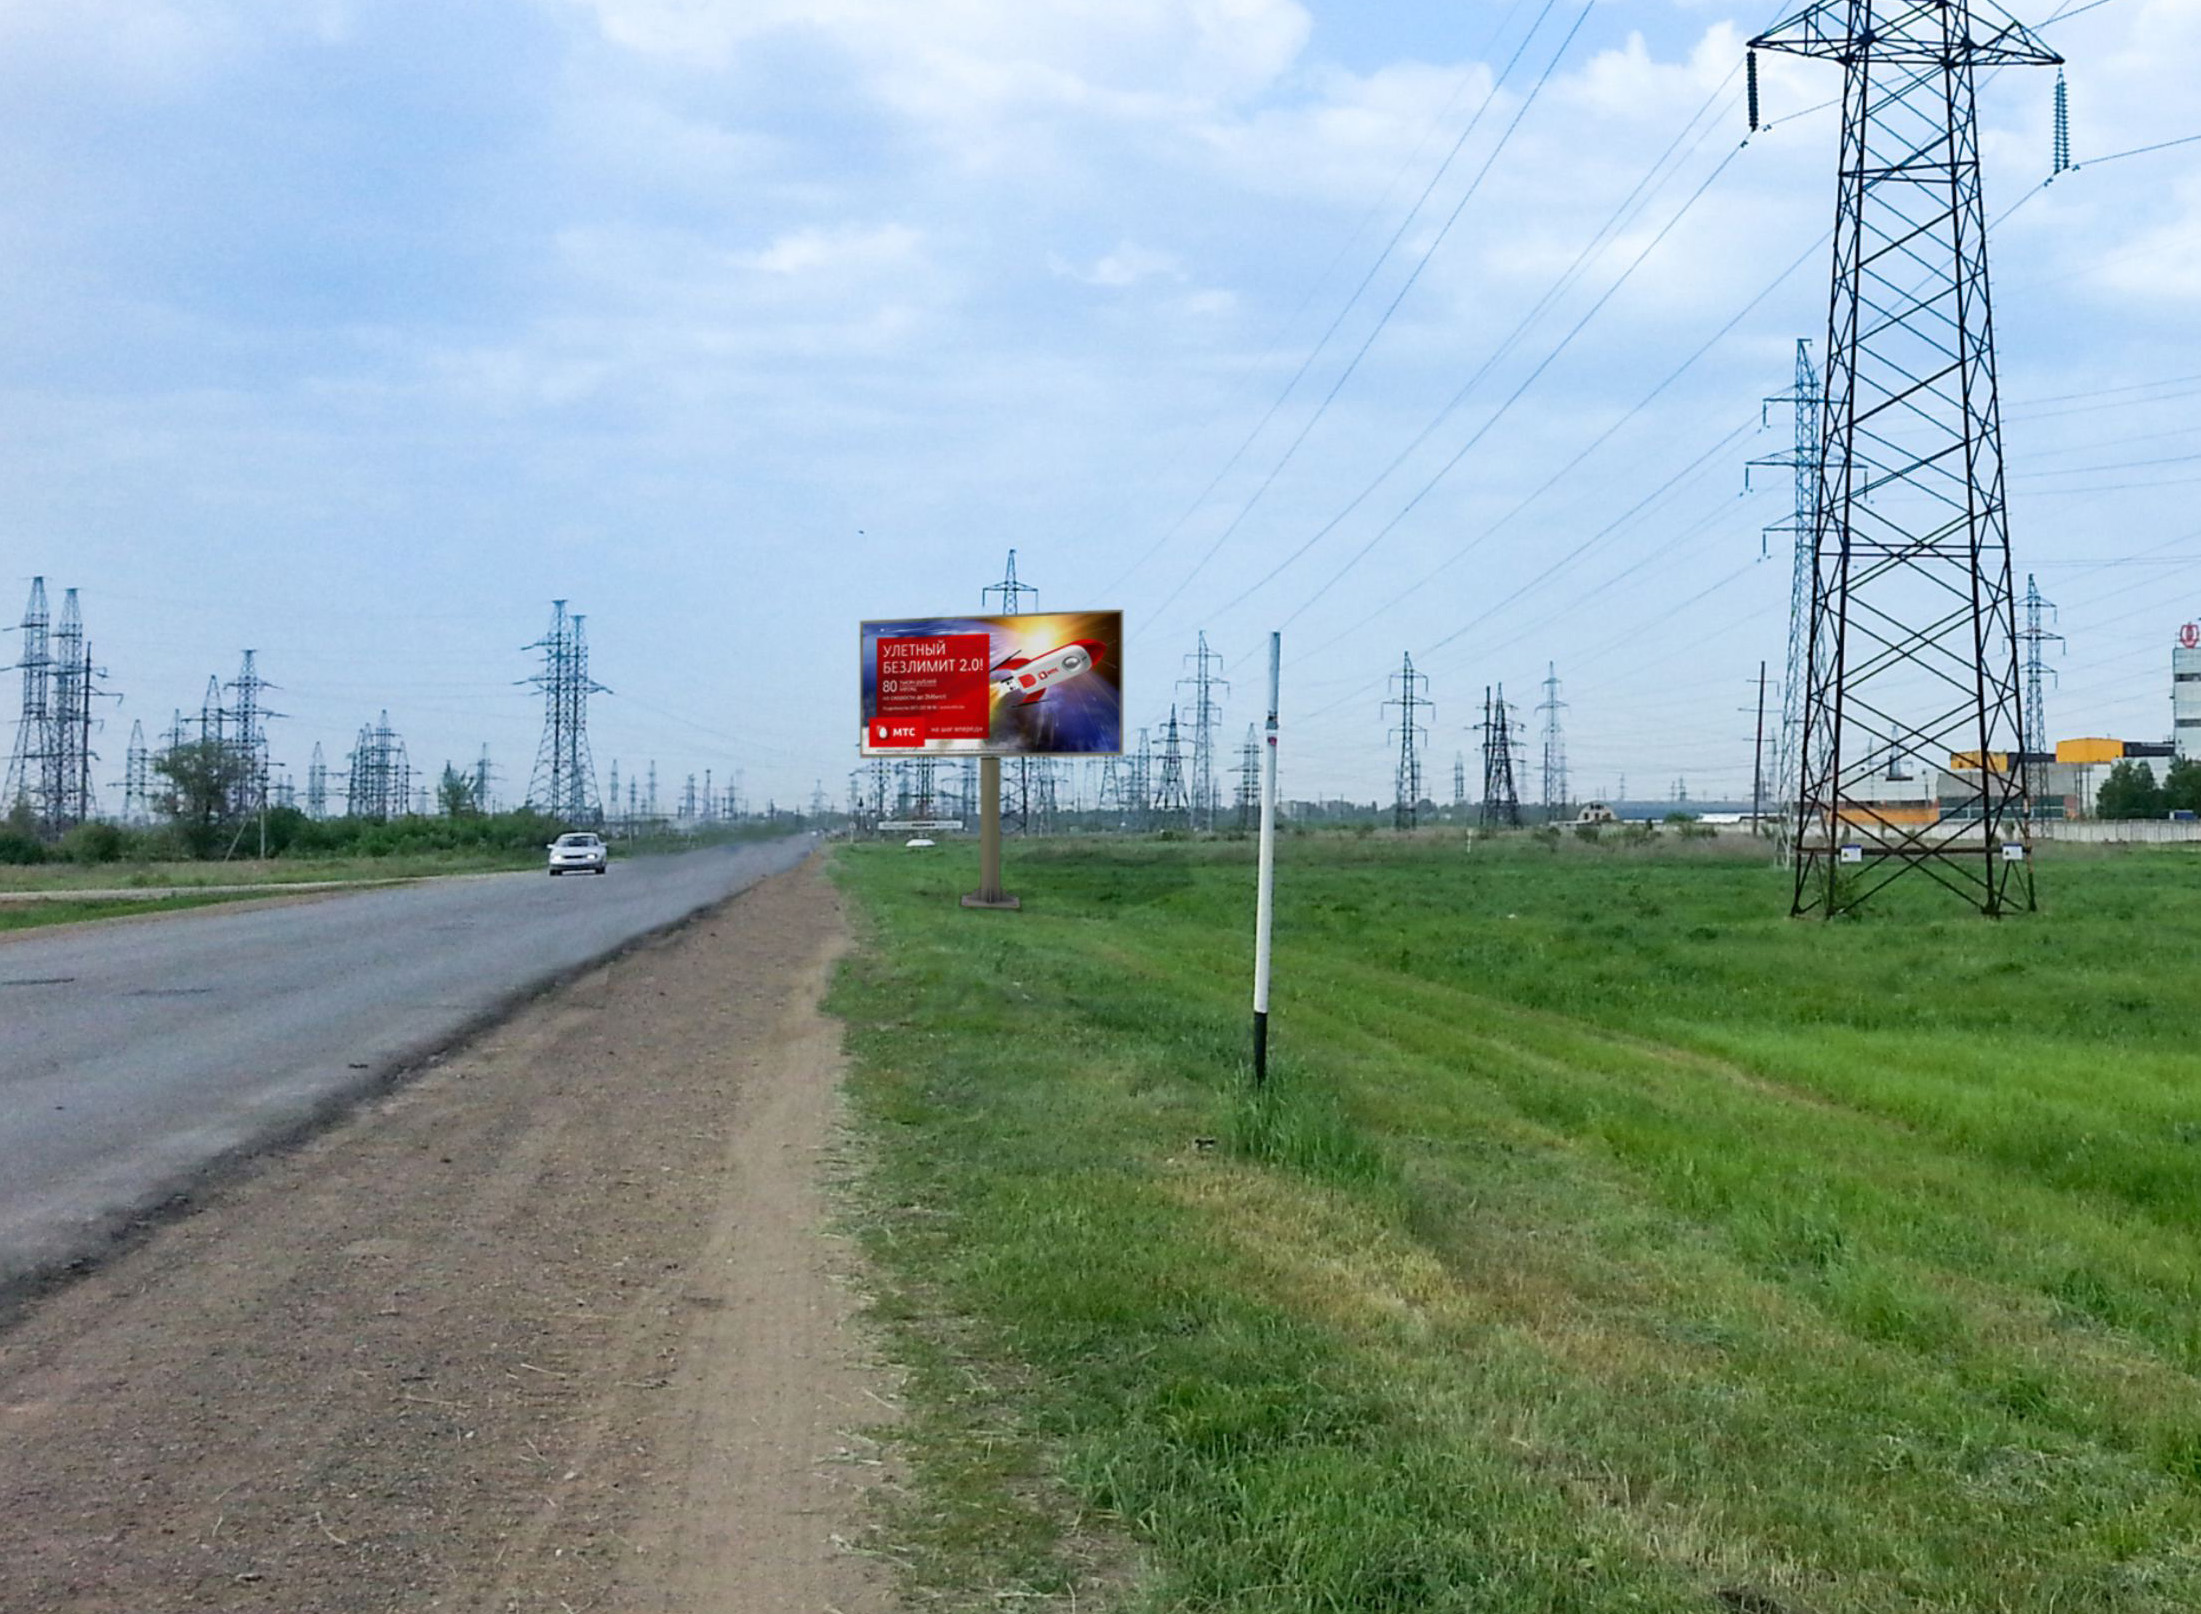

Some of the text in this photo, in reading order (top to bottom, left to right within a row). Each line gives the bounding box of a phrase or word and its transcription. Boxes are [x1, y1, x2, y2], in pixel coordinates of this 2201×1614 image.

[883, 639, 946, 658] УЛЕТНЫЙ
[883, 657, 984, 674] БЕЗЛИМИТ 2.0!
[882, 680, 897, 693] 80
[893, 727, 915, 737] МТС
